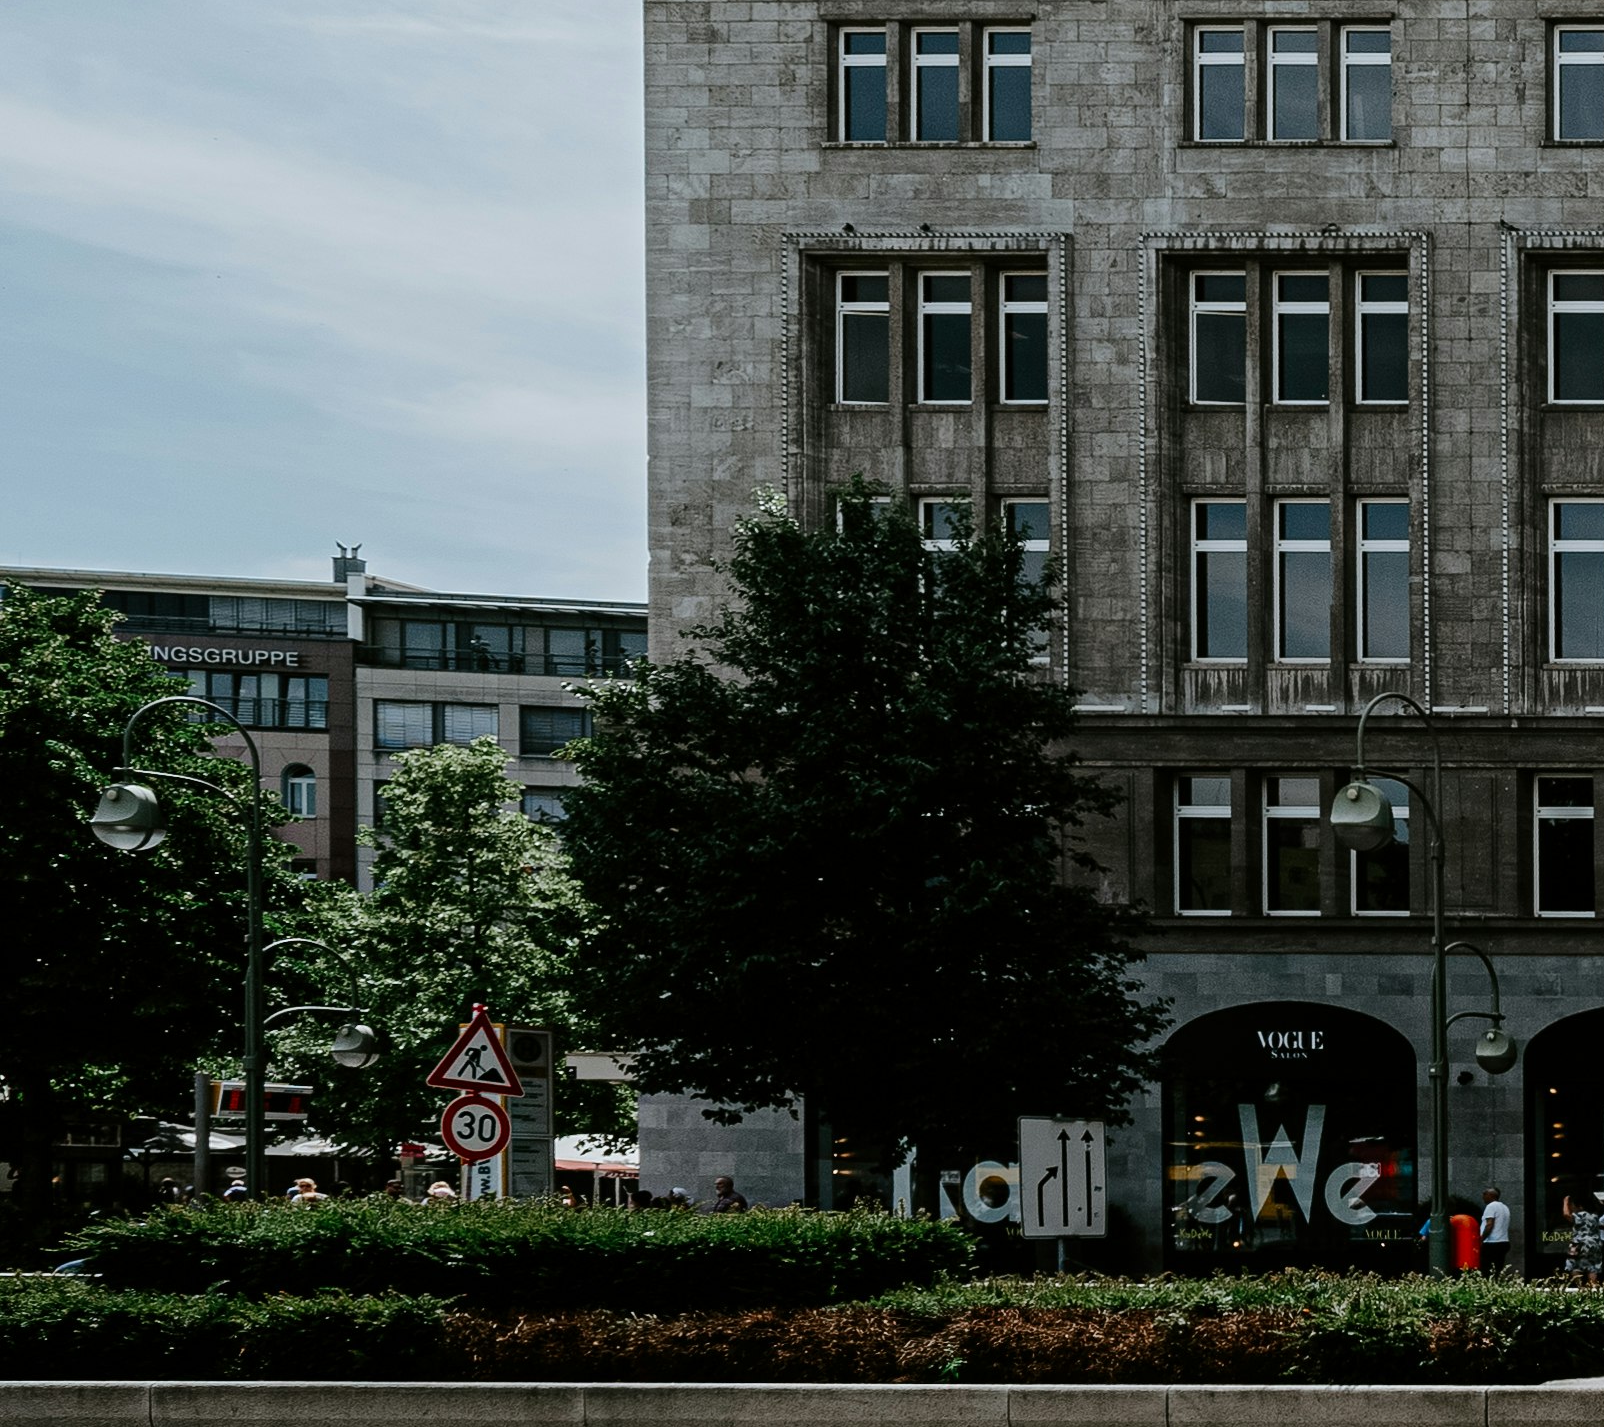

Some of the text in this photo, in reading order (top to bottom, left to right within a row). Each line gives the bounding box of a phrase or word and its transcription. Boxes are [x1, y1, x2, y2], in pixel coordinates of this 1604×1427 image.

[148, 645, 299, 667] NGSGRUPPE
[1257, 1030, 1324, 1051] VOGUE
[456, 1110, 496, 1143] 30
[1179, 1228, 1402, 1240] KaDeWe VOGUE
